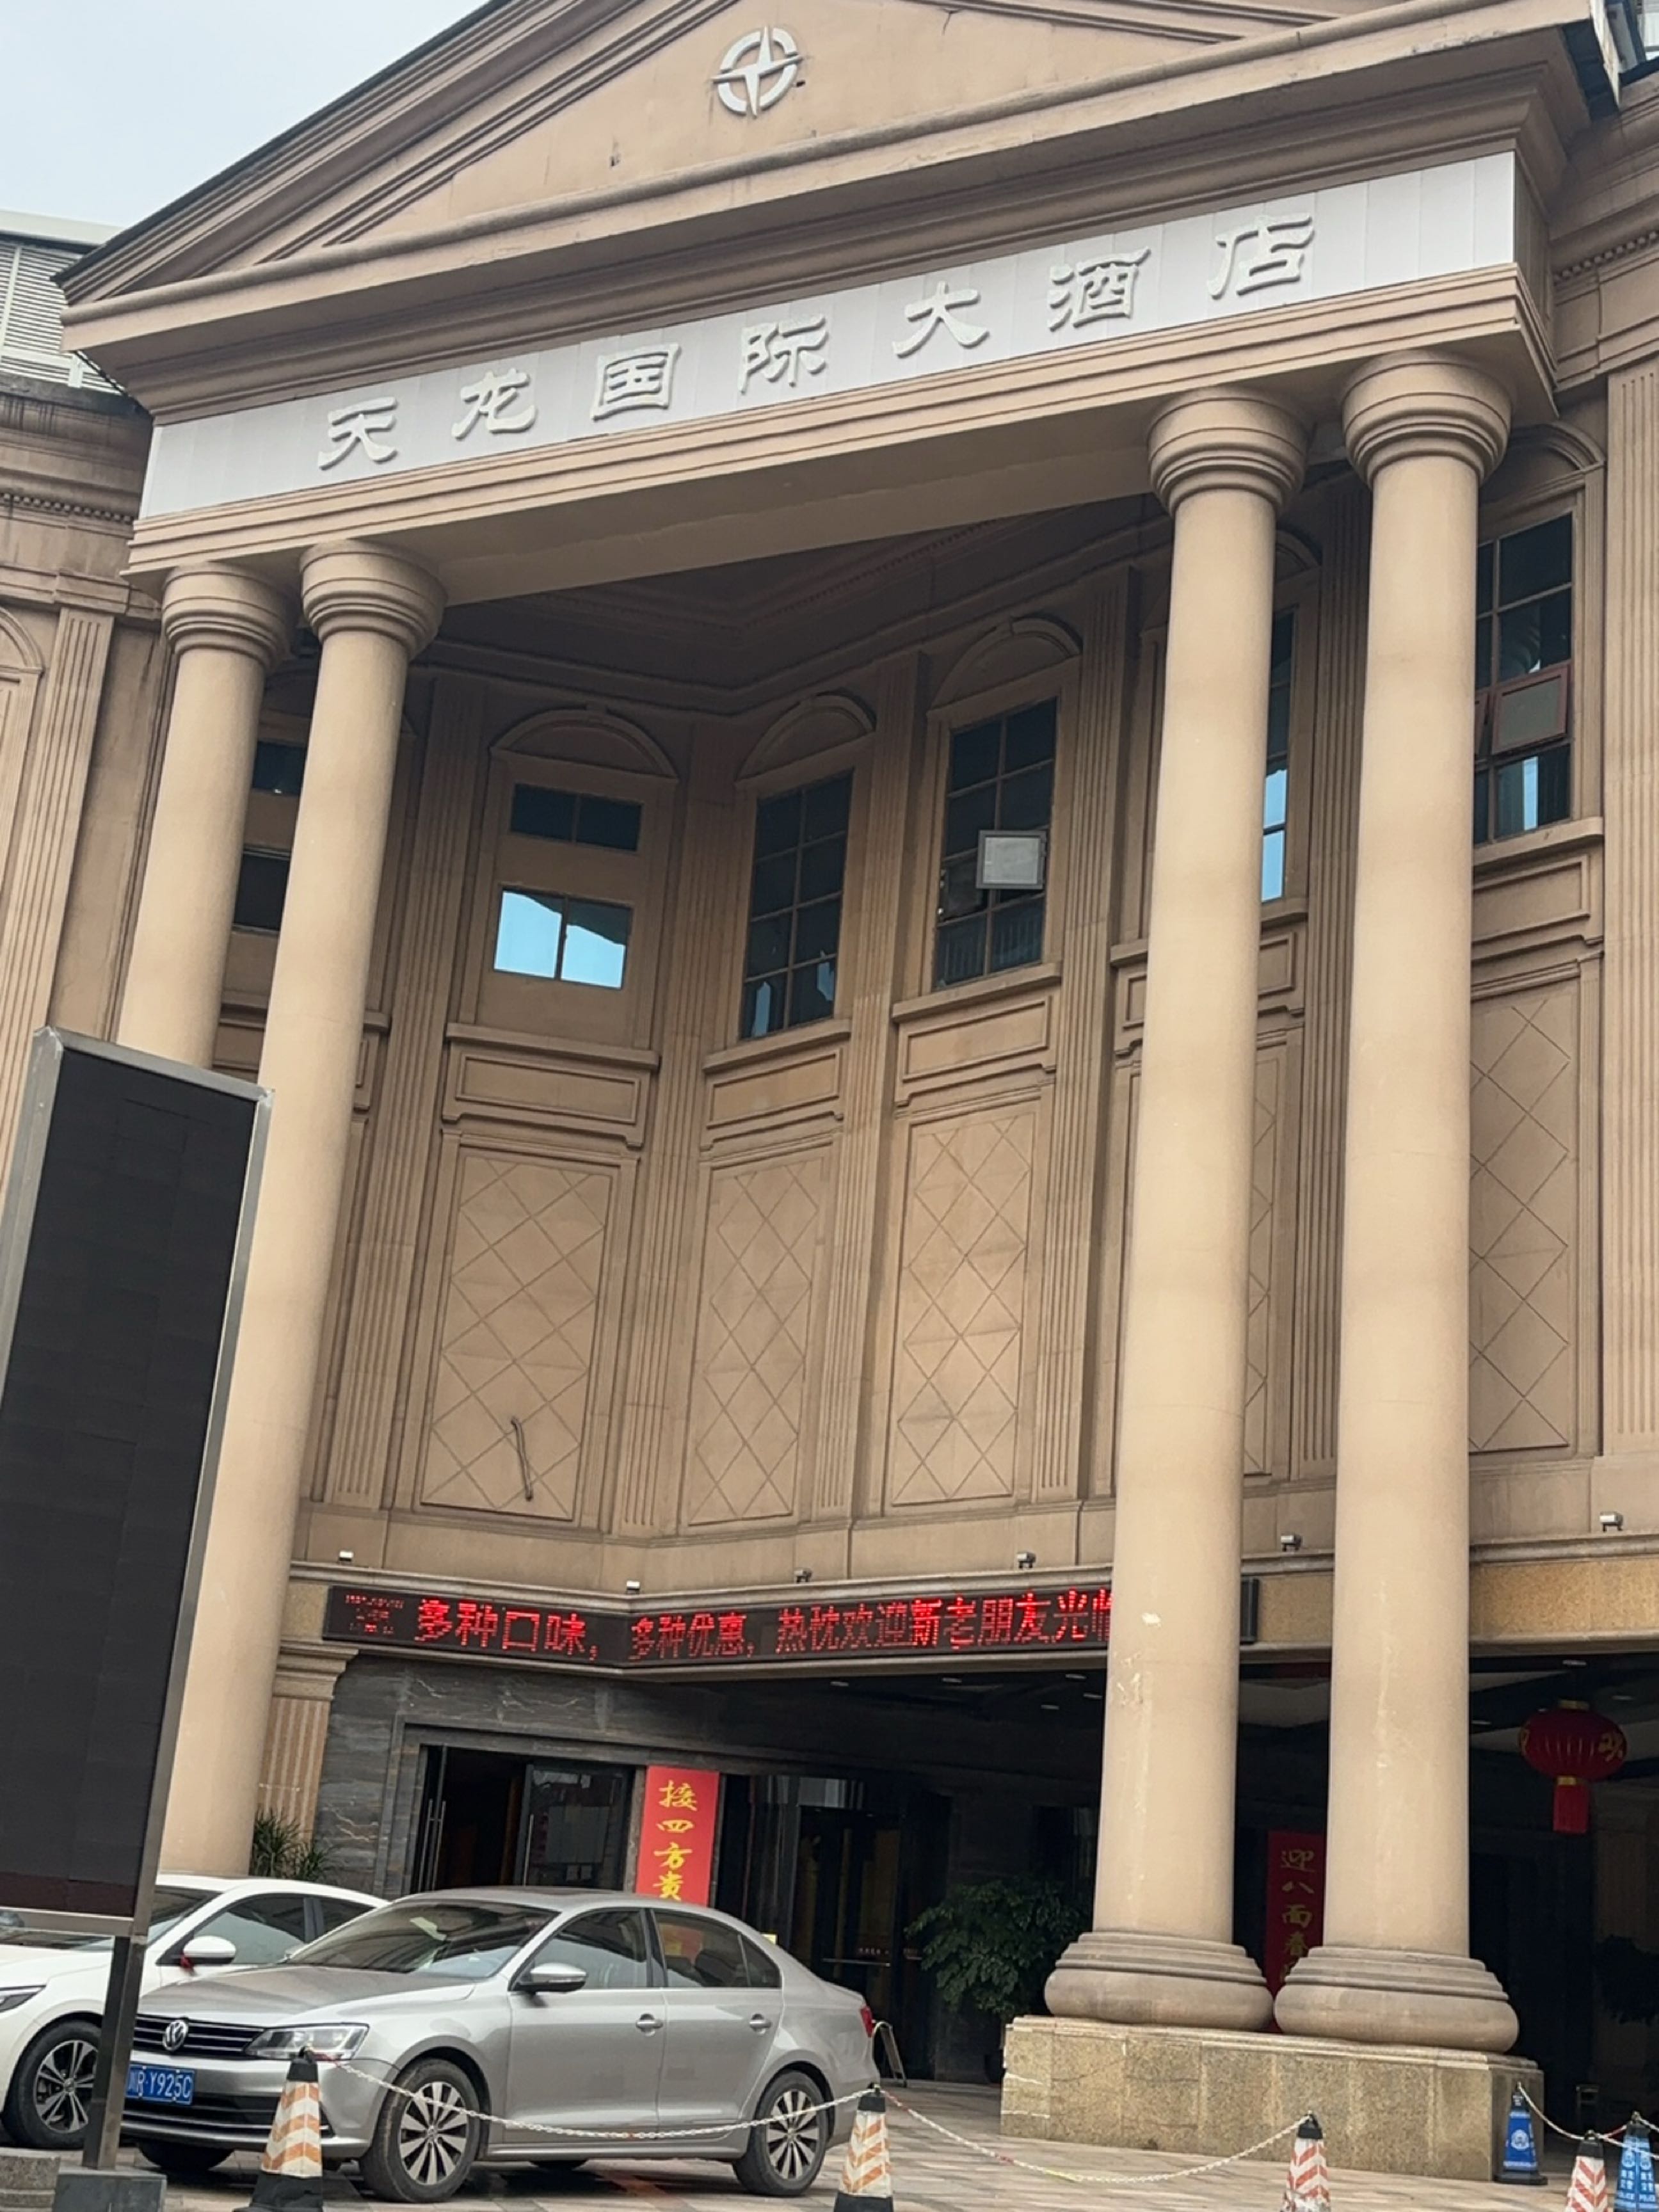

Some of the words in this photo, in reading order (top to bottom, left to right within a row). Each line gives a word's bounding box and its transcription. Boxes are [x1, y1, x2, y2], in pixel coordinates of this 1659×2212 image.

[317, 211, 1315, 470] 天龙国际大酒店
